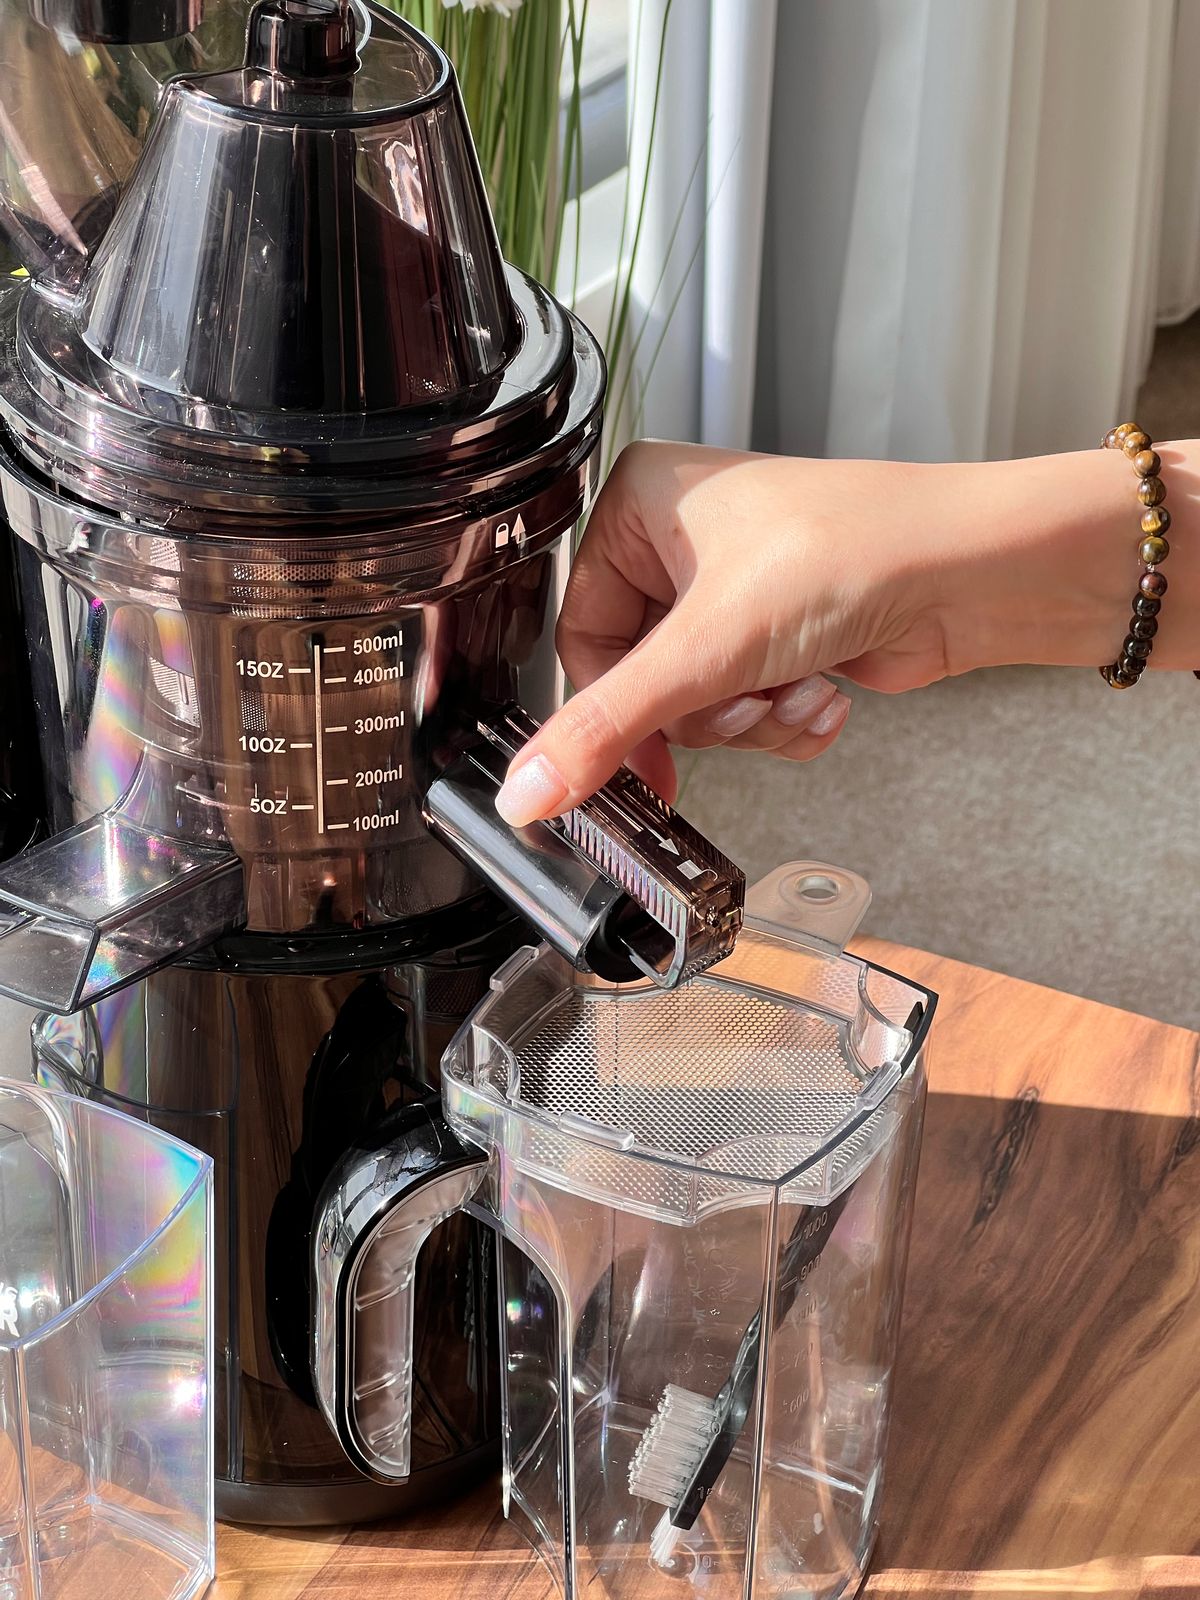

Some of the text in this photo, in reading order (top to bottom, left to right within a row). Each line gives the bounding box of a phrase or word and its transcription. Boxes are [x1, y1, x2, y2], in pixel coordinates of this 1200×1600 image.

[353, 630, 403, 655] 500ml
[236, 659, 284, 678] 15OZ
[353, 661, 404, 686] 400ml
[354, 710, 405, 735] 300ml
[238, 735, 287, 754] 10OZ
[355, 764, 403, 788] 200ml
[250, 798, 287, 815] 5OZ
[352, 809, 400, 832] 100ml
